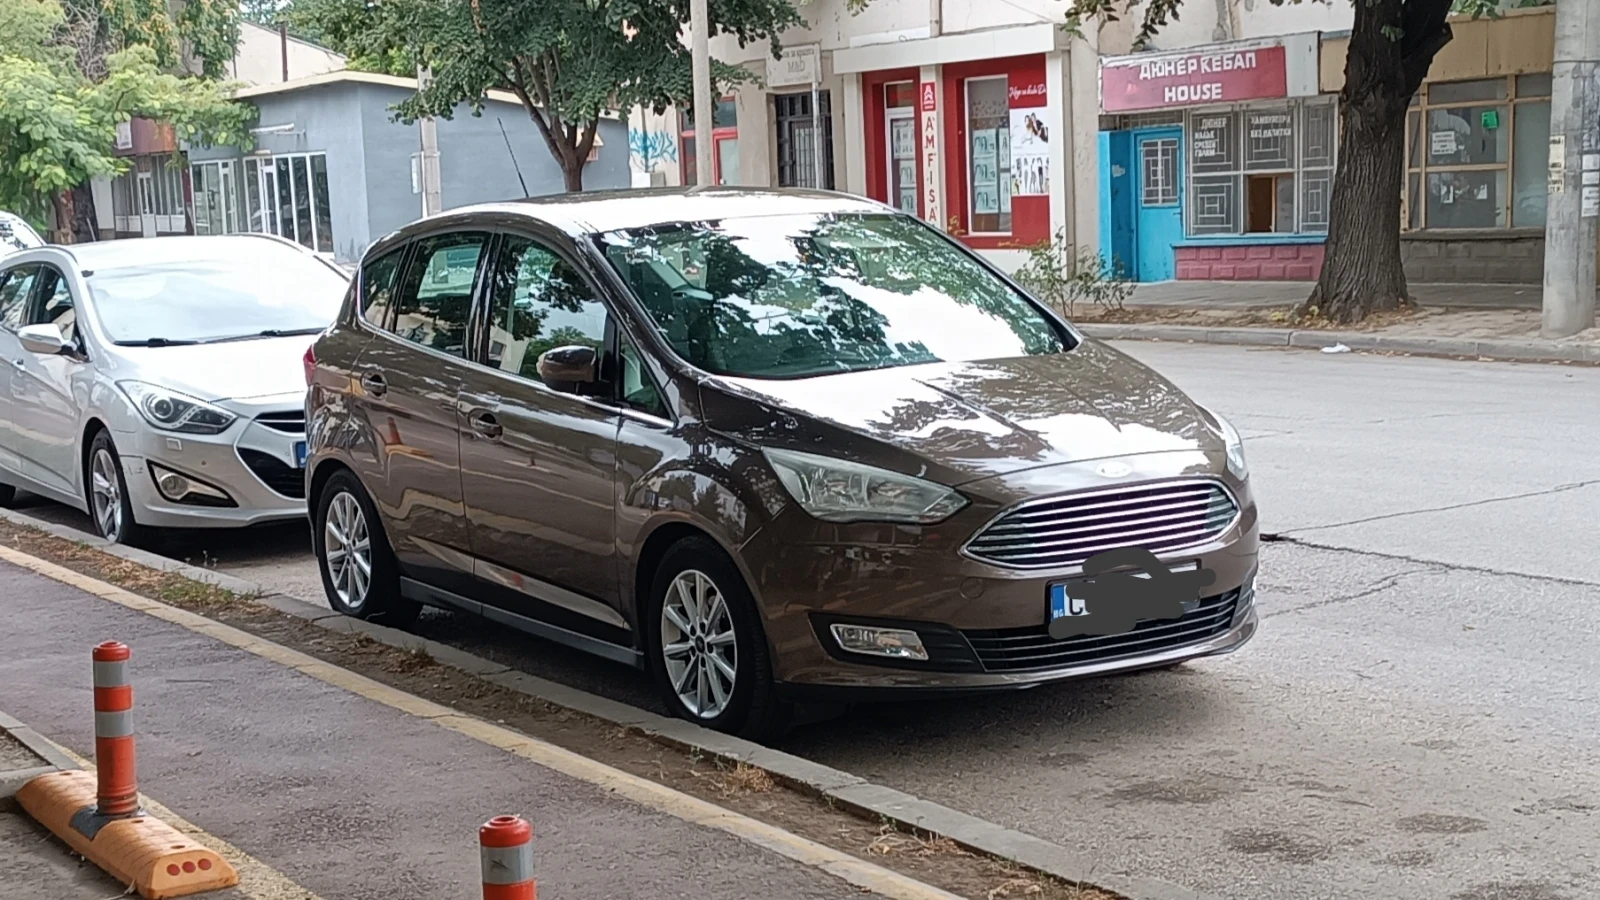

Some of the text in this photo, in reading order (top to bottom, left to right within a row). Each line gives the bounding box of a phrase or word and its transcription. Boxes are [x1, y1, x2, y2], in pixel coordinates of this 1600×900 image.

[1139, 52, 1257, 80] ДЮНЕР КЕБАП
[1164, 83, 1223, 103] HOUSE
